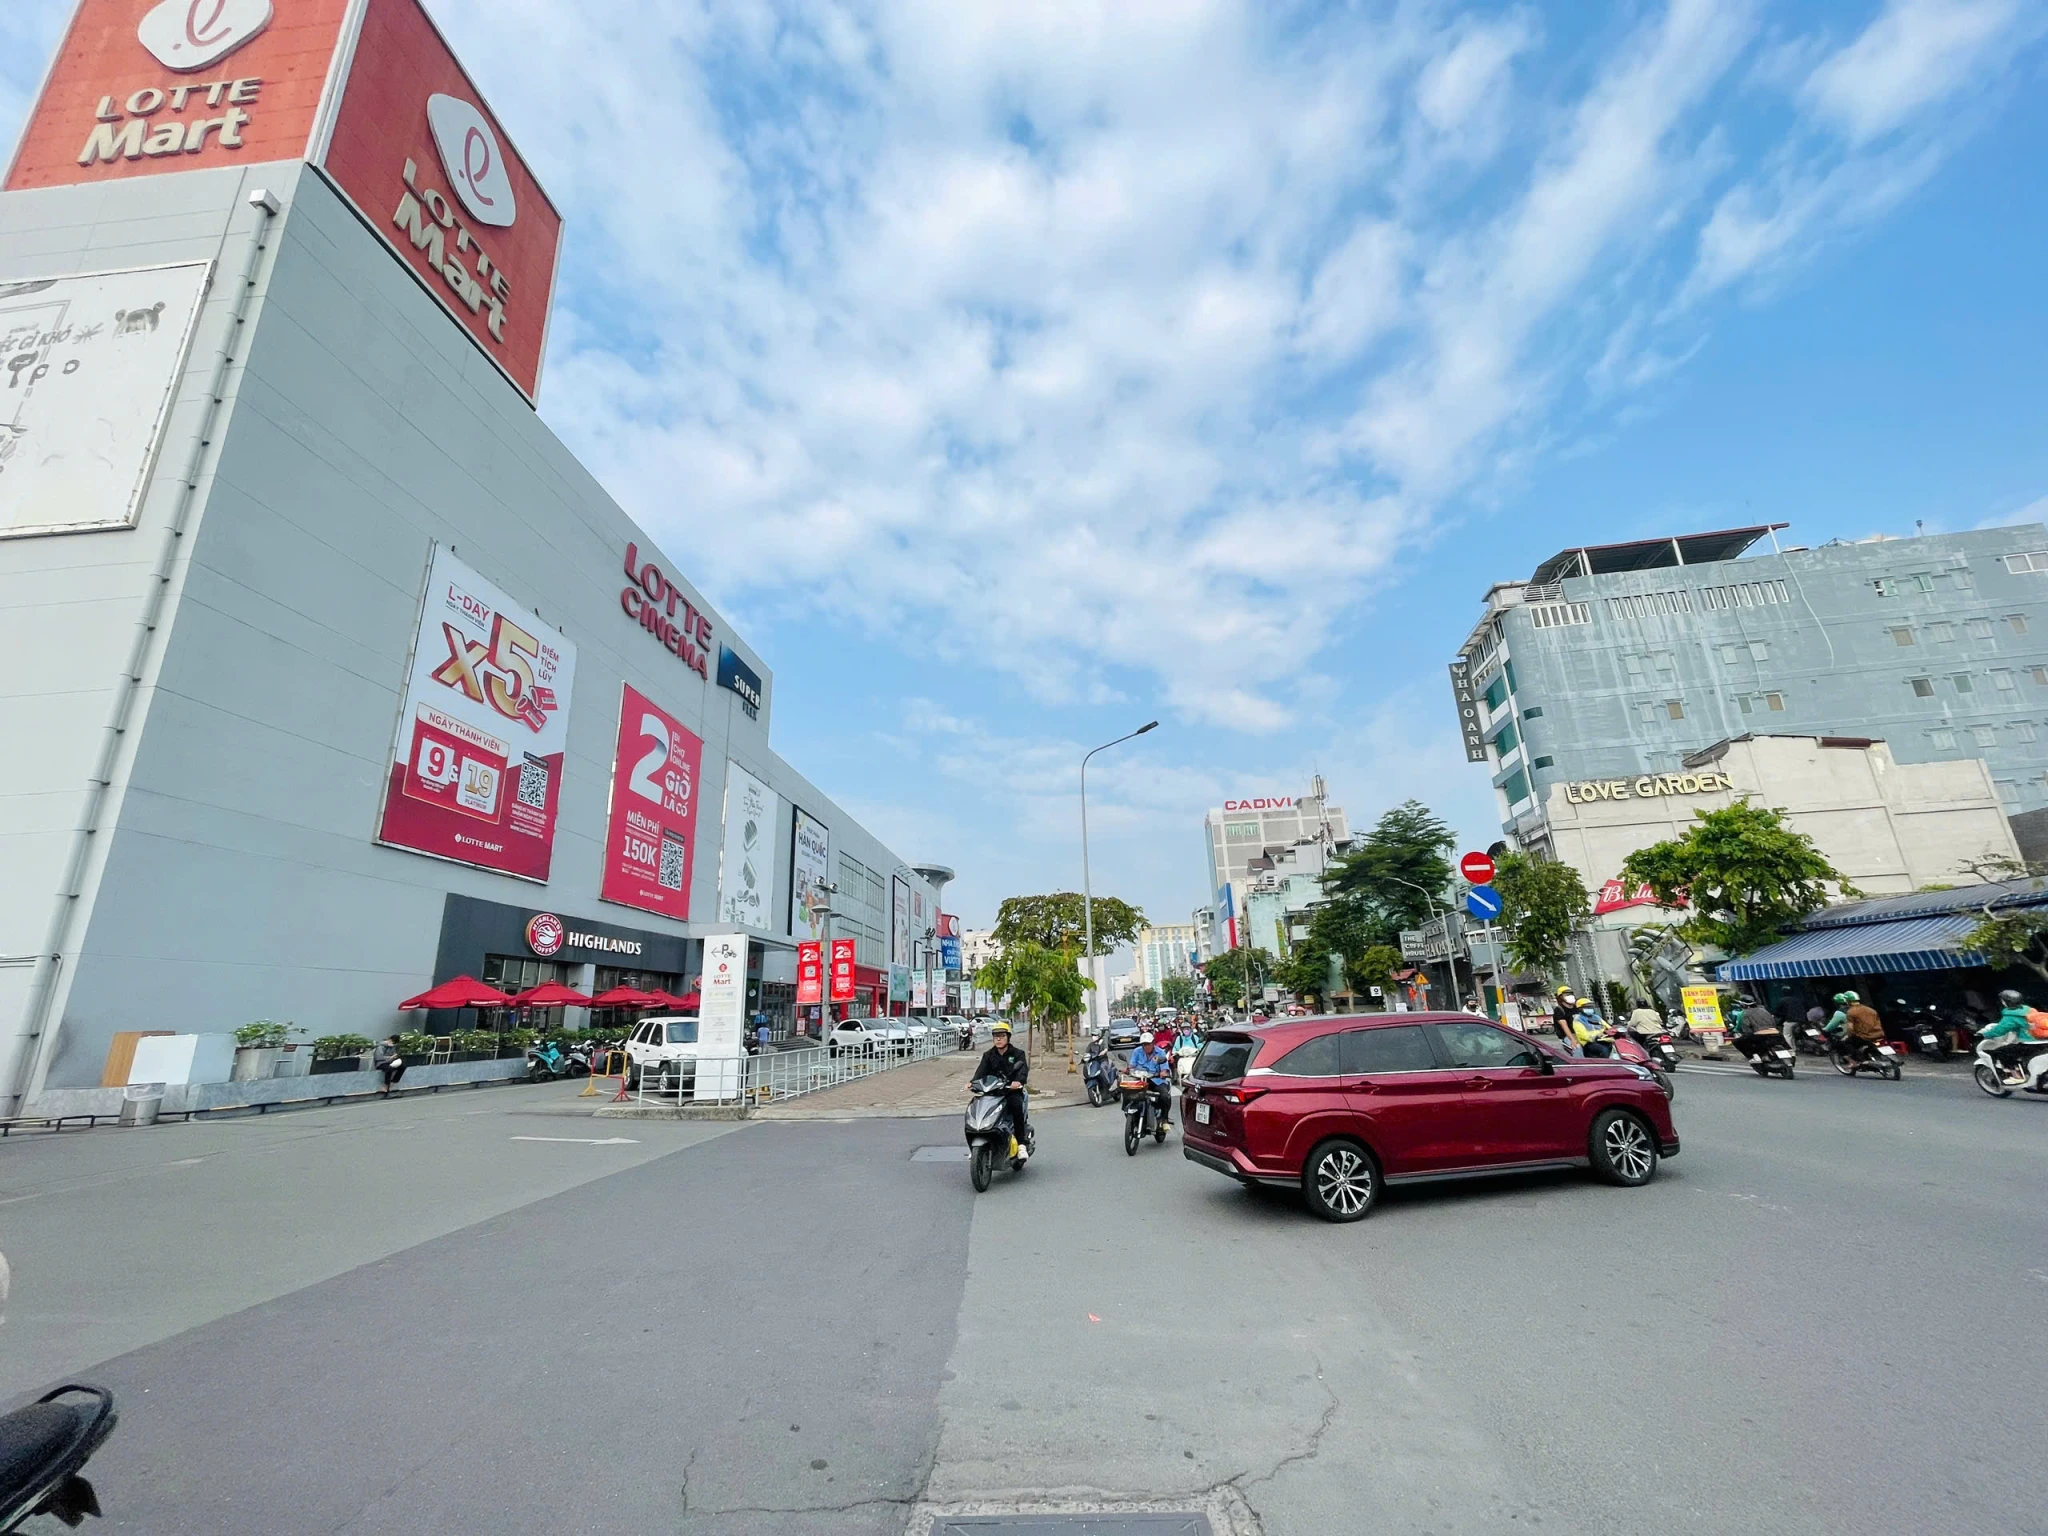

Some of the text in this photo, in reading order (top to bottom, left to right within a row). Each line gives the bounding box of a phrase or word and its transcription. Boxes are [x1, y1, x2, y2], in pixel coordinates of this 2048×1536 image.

[95, 77, 264, 122] LOTTE
[77, 107, 251, 167] Mart
[403, 157, 512, 304] LOTTE
[393, 191, 507, 344] Mart
[448, 585, 490, 622] L-DAY
[624, 541, 713, 652] LOTTE
[621, 587, 708, 681] CINEMA
[733, 674, 761, 710] SUPER
[428, 712, 500, 752] NGÀY THÀNH VIÊN
[428, 747, 445, 777] 9
[465, 763, 494, 798] 19
[629, 713, 670, 805] 2
[672, 755, 691, 773] ONLINE
[664, 794, 689, 818] LÀ CÓ
[1225, 797, 1291, 811] CADIVI
[1565, 773, 1734, 804] LOVE GARDEN
[462, 836, 503, 853] LOTTE MART
[647, 819, 660, 835] PHÍ
[623, 835, 657, 867] 150K
[568, 932, 642, 955] HIGHLANDS
